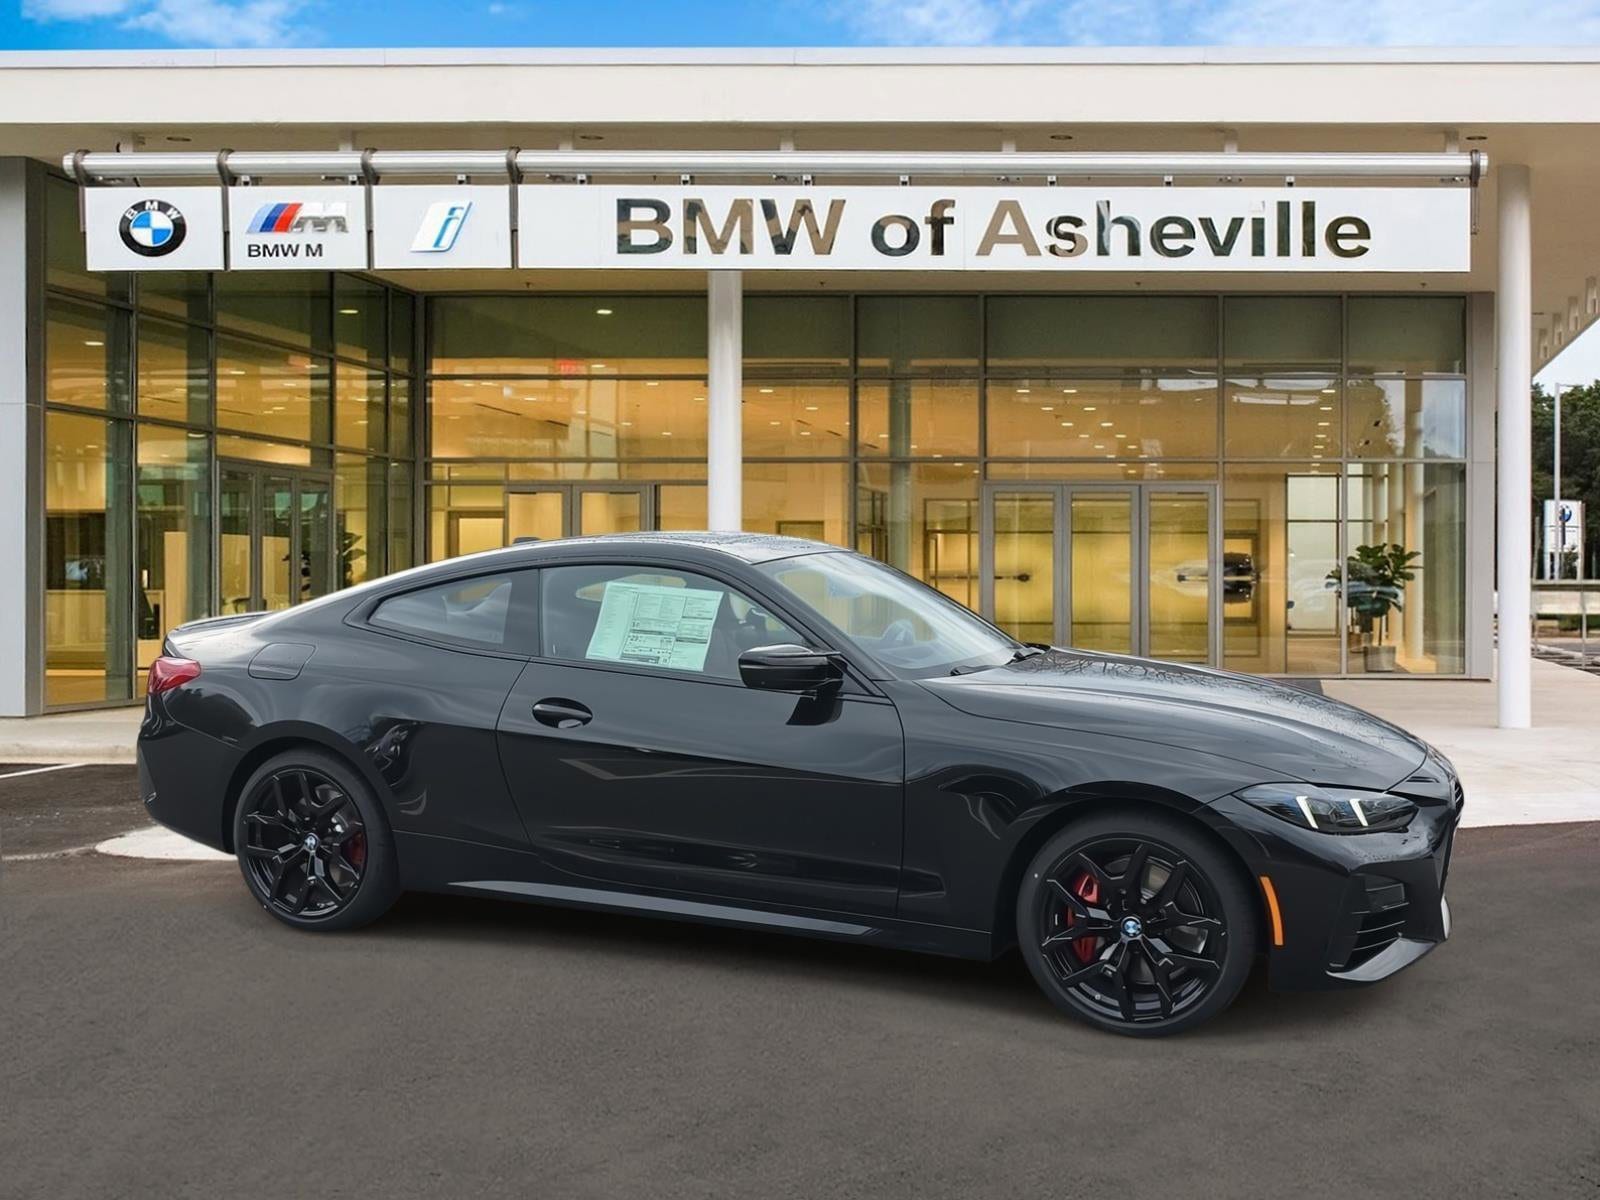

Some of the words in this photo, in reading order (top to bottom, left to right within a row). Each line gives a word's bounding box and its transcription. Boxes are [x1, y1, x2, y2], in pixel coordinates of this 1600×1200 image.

[124, 200, 182, 221] BMW
[616, 198, 846, 255] BMW
[871, 199, 955, 256] of
[976, 199, 1371, 258] Asheville
[247, 243, 299, 258] BMW
[305, 243, 323, 258] M
